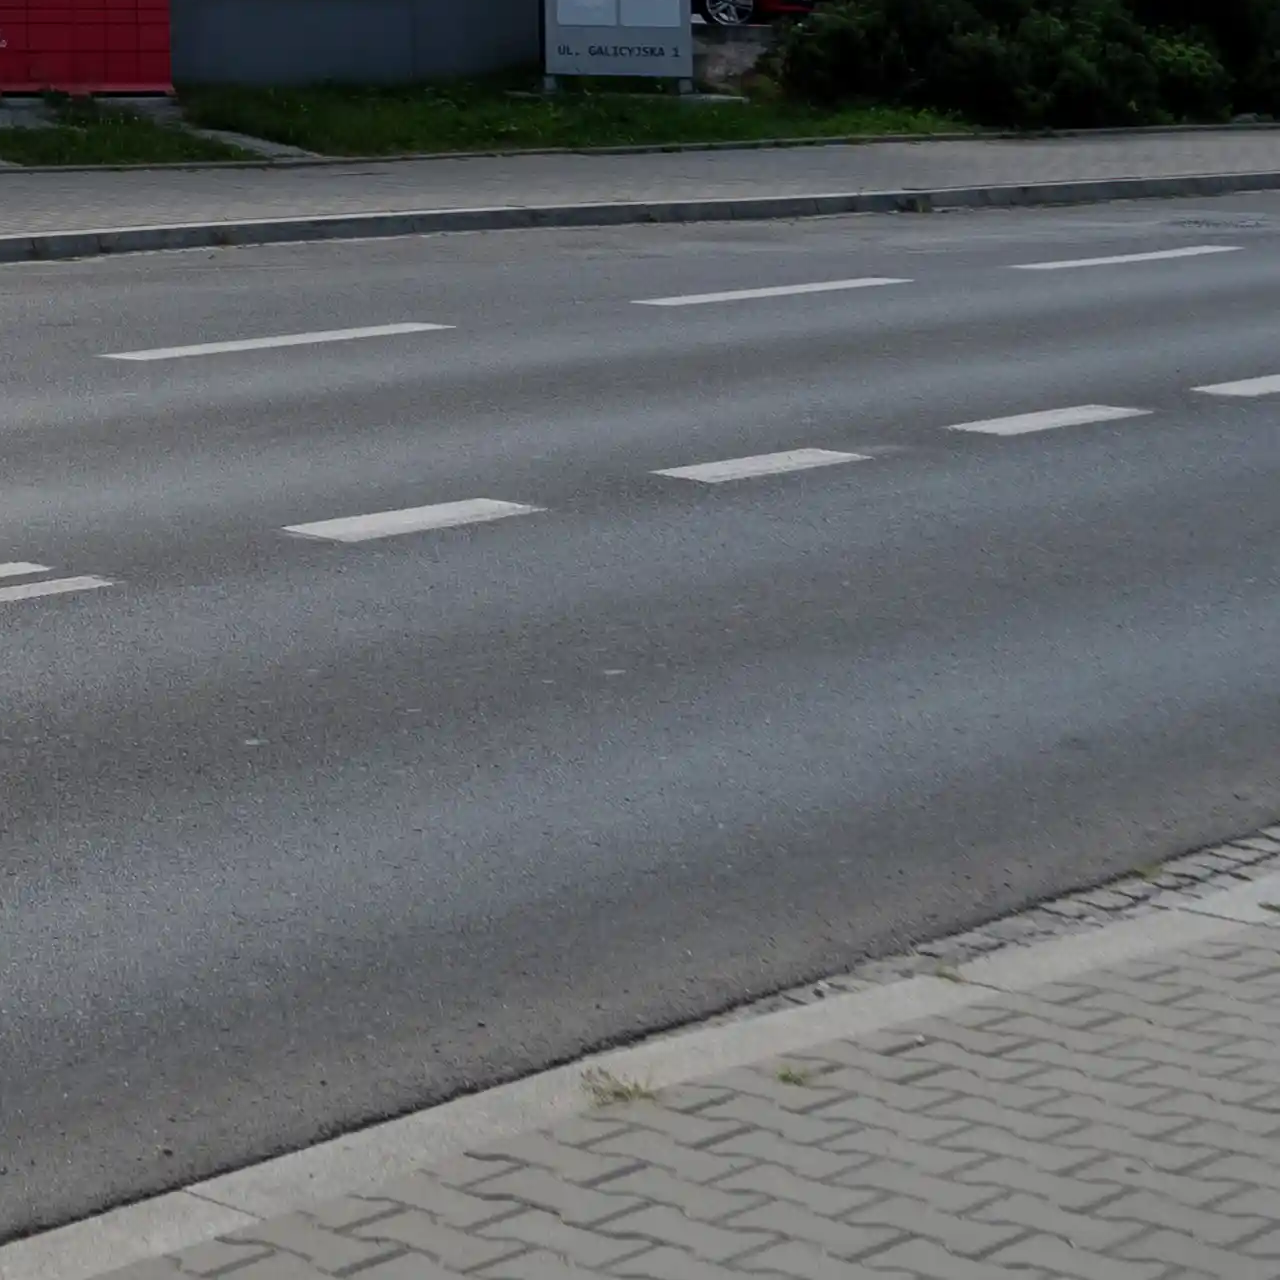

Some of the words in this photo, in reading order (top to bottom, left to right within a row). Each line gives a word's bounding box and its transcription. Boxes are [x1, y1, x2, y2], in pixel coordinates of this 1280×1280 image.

[558, 45, 580, 56] UL.
[588, 45, 665, 57] GALICYJSKA
[671, 46, 681, 57] 1
